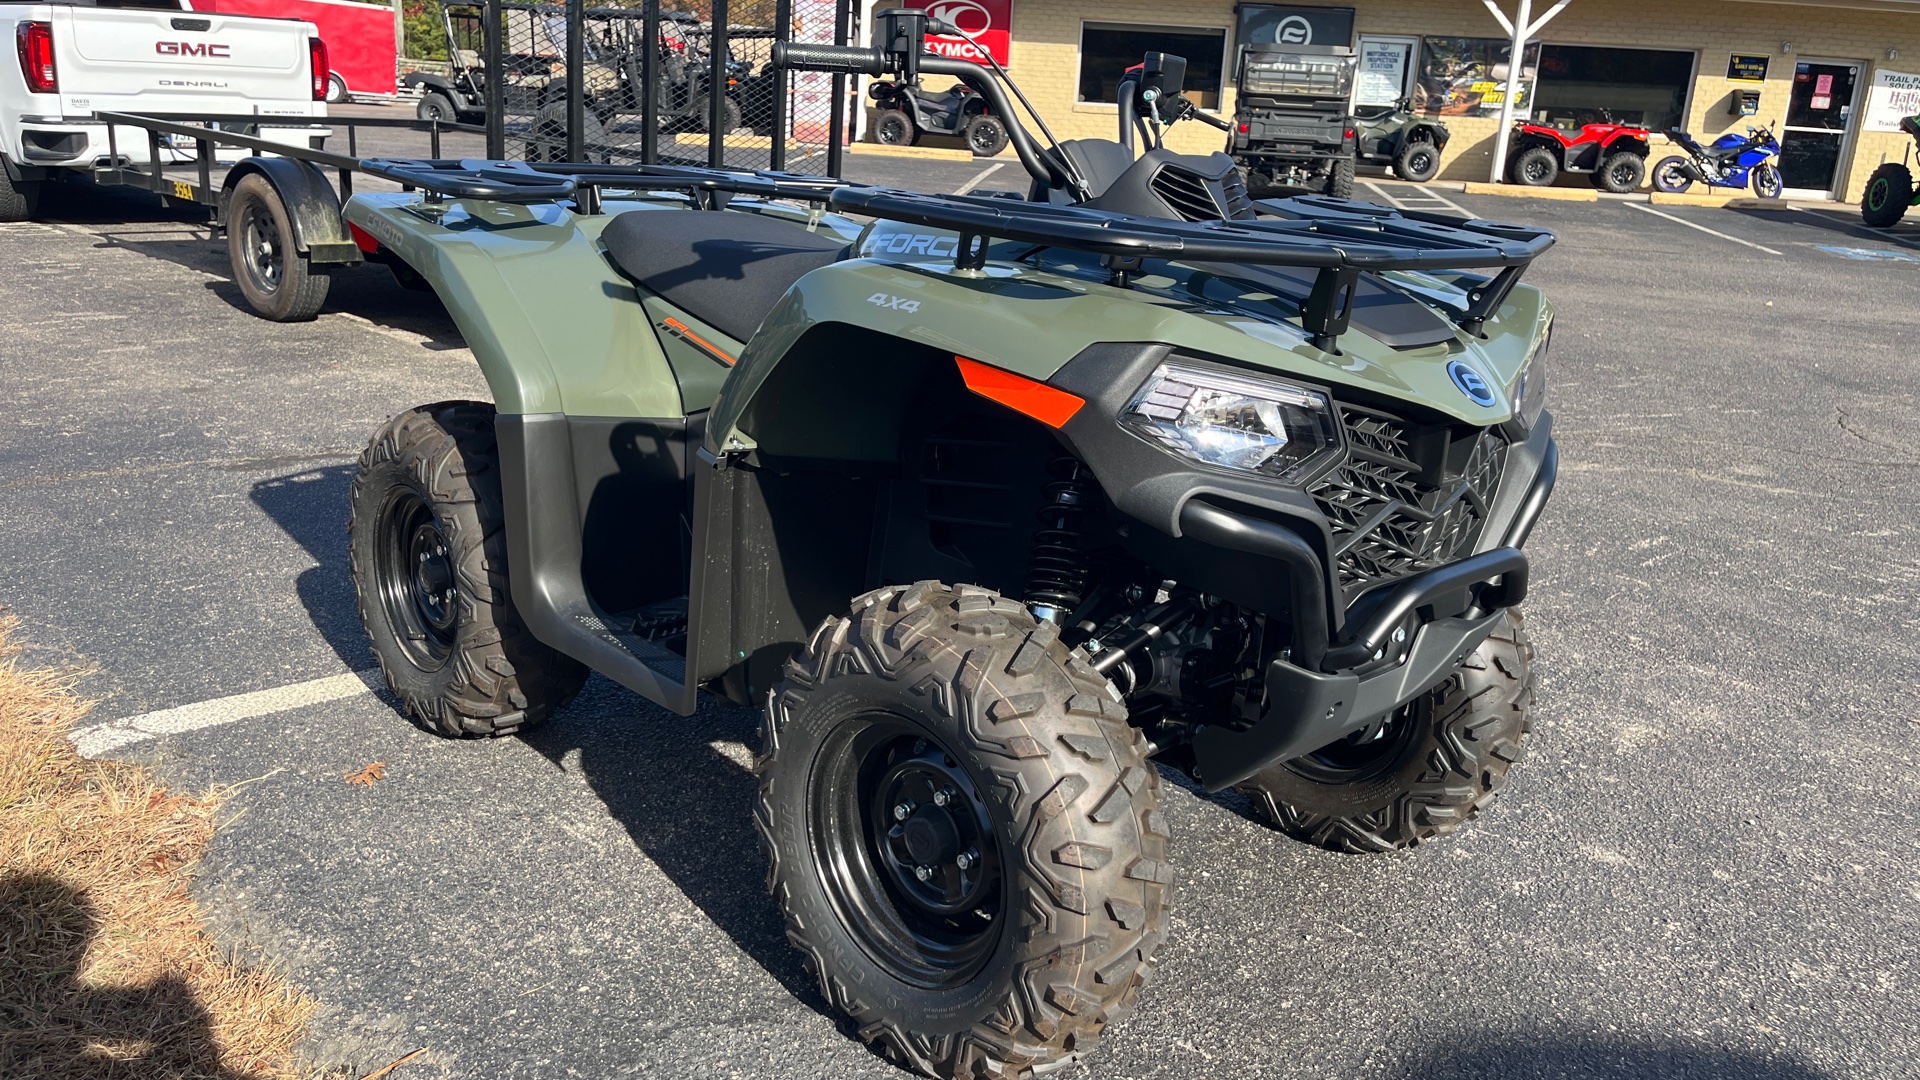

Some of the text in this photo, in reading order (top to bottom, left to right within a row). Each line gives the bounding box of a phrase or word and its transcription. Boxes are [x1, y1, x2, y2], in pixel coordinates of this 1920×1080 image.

[155, 41, 230, 58] GMC
[1884, 75, 1910, 84] TRAIL
[1889, 82, 1913, 90] SOLD
[1889, 91, 1920, 106] Hatfi
[366, 213, 404, 247] CFMOTO
[866, 292, 921, 314] 4X4
